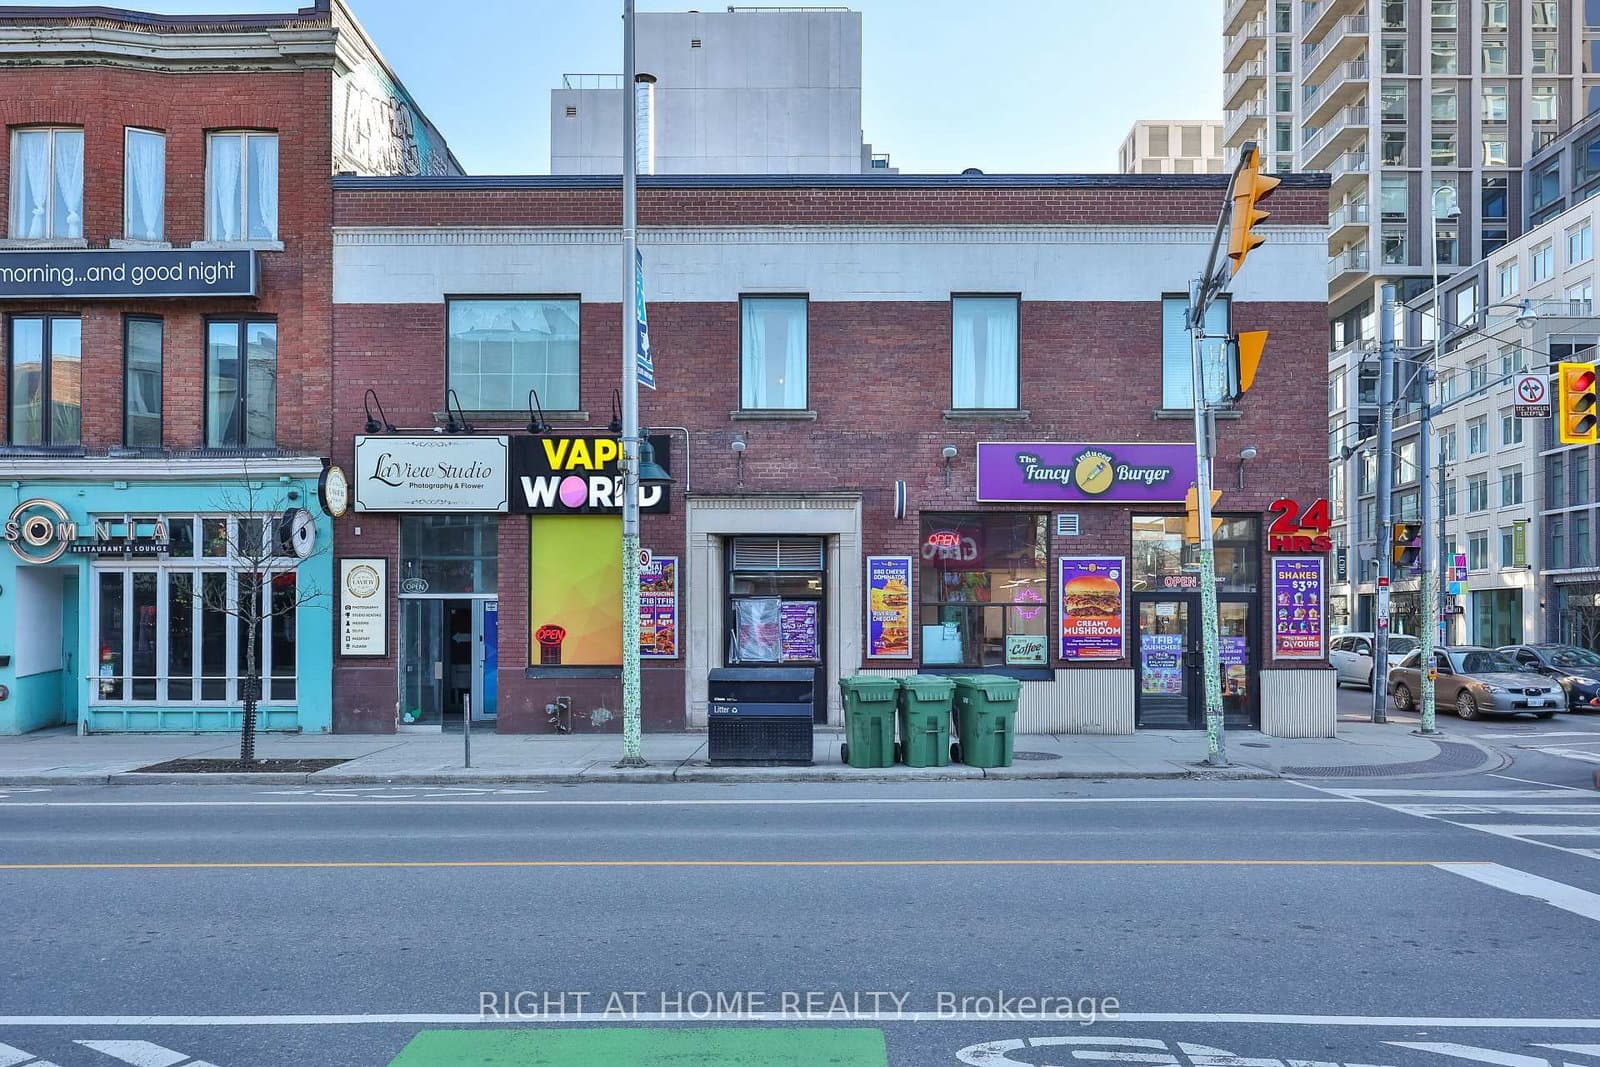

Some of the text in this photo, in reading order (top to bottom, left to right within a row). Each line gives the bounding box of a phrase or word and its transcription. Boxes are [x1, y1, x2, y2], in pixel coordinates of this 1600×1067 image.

[131, 262, 182, 285] good
[188, 261, 236, 284] night
[438, 461, 492, 478] Studio
[1026, 464, 1170, 484] Fancy Burger
[1268, 498, 1332, 533] 24
[928, 534, 960, 546] OPEN
[1268, 534, 1332, 552] HRS
[1164, 576, 1196, 588] OPEN
[1279, 572, 1318, 580] SHAKES
[538, 630, 564, 640] OPEN
[1150, 636, 1173, 644] TFIB
[1012, 642, 1042, 656] Coffee
